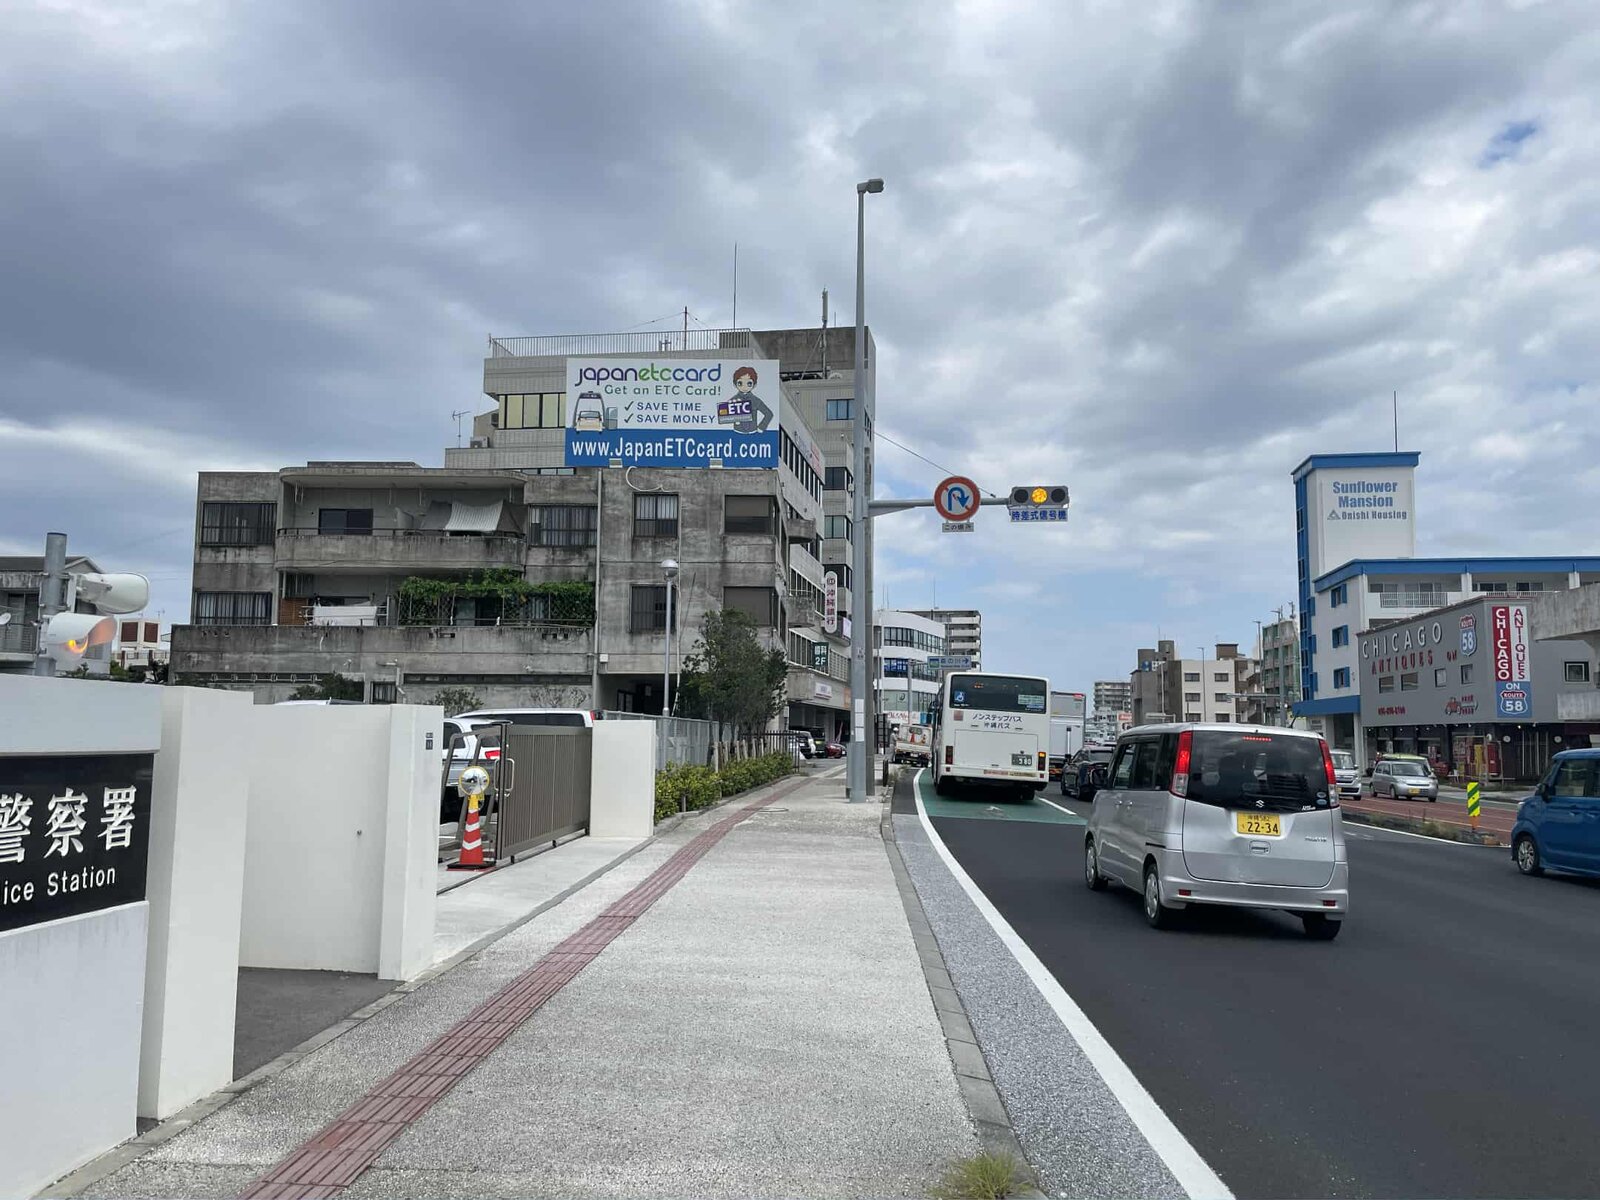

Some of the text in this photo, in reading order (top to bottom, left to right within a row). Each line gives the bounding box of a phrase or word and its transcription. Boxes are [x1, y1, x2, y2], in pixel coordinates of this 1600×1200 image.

[575, 363, 721, 387] japanetccard
[604, 384, 721, 396] Get an ETC Card!
[636, 402, 702, 411] SAVE TIME
[727, 400, 751, 415] ETC
[636, 414, 716, 424] SAVE MONEY
[572, 437, 772, 462] www.JapanETCcard.com
[1333, 481, 1398, 493] Sunflower
[1338, 495, 1393, 508] Mansion
[1012, 510, 1067, 521] 時差式信号機
[1342, 510, 1407, 520] Onishi Housing
[1362, 622, 1442, 659] CHICAGO
[1462, 631, 1474, 651] 58
[1496, 608, 1510, 680] CHICAGO
[1514, 608, 1526, 680] ANTIQUES
[815, 656, 827, 666] 2F
[1371, 650, 1433, 675] ANTIQUES
[1505, 682, 1520, 690] ON
[1505, 700, 1523, 711] 58
[47, 866, 116, 897] Station
